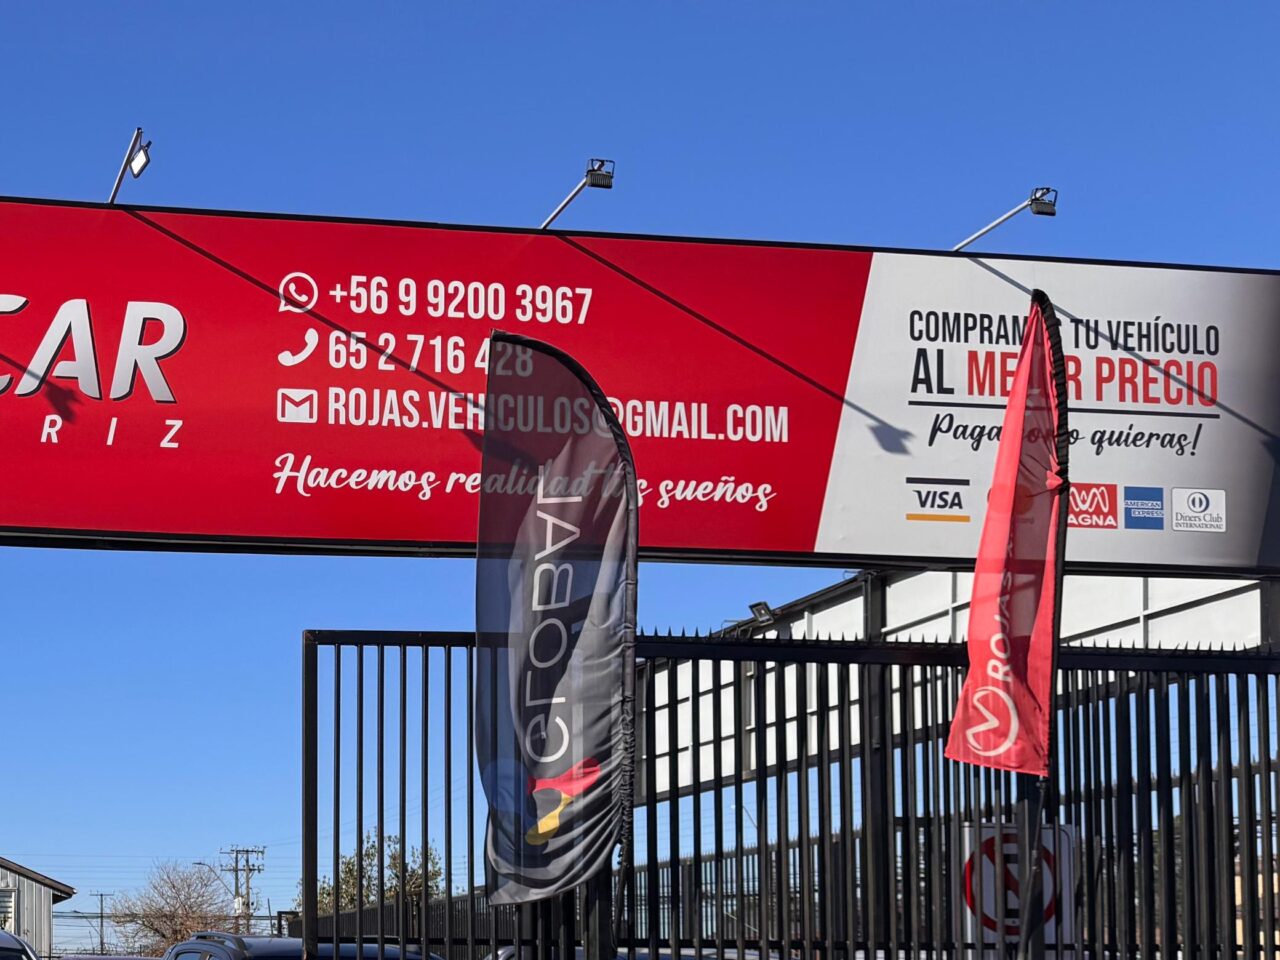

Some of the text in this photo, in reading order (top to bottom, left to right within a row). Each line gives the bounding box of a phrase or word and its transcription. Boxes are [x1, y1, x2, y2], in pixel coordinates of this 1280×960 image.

[329, 276, 593, 325] +56 9 9200 3967
[909, 310, 1220, 356] COMPRAM TU VEHÍCULO
[328, 334, 534, 377] 65 2 716 428
[910, 348, 955, 395] AL
[967, 350, 1082, 401] MER
[1095, 356, 1219, 407] PRECIO
[1091, 423, 1203, 456] quieras!
[272, 453, 440, 499] Hacemos
[445, 459, 596, 498] realidad
[657, 475, 776, 512] sueños
[912, 489, 963, 510] VISA
[1124, 501, 1161, 509] AMERICAN
[1132, 510, 1164, 518] EXPRESS
[1066, 515, 1117, 527] AGNA
[1175, 512, 1223, 523] Diners Club
